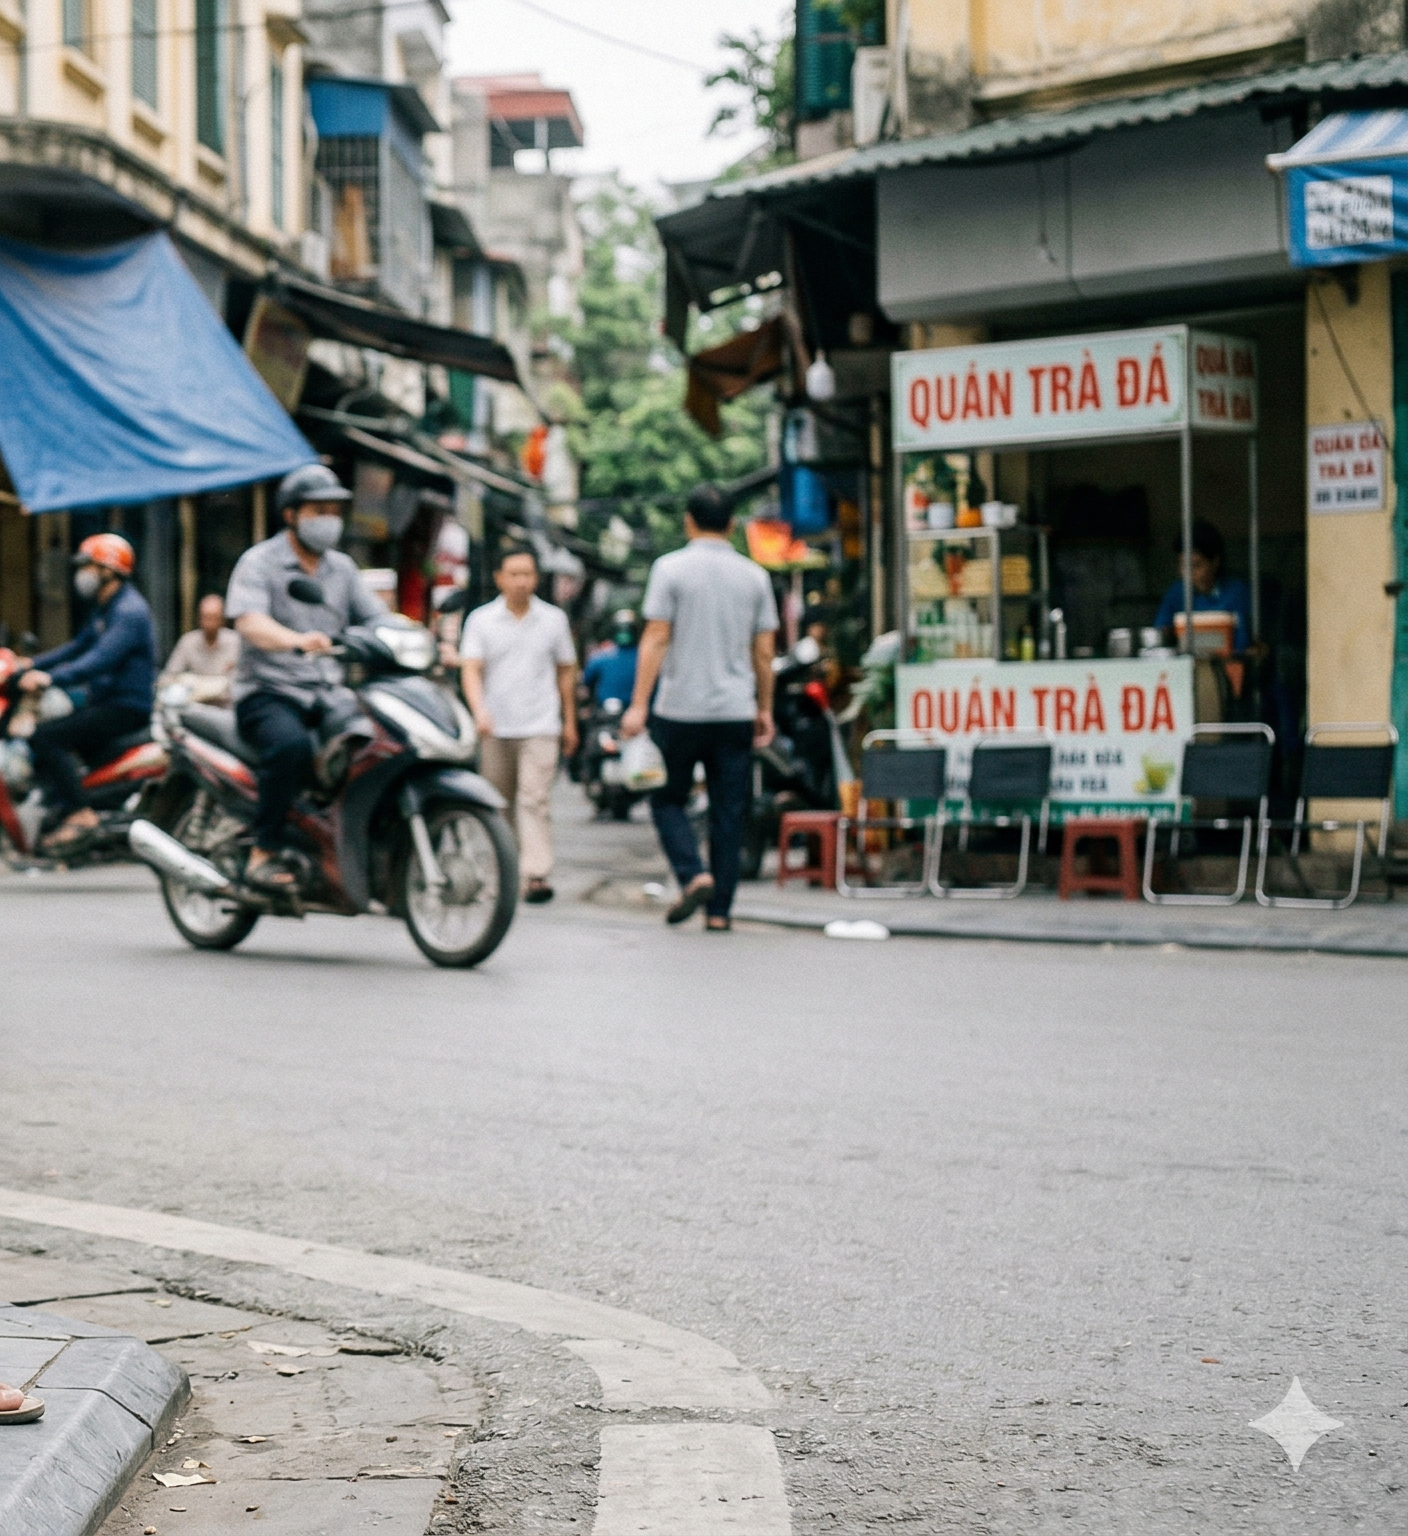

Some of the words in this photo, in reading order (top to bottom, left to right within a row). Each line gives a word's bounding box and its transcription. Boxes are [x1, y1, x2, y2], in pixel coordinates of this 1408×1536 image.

[910, 360, 1012, 428] QUÁN
[1029, 350, 1100, 413] TRÀ
[1117, 342, 1169, 407] ĐÁ
[911, 677, 1016, 742] QUÁN
[1031, 672, 1105, 732] TRÀ
[1120, 670, 1175, 733] ĐÁ
